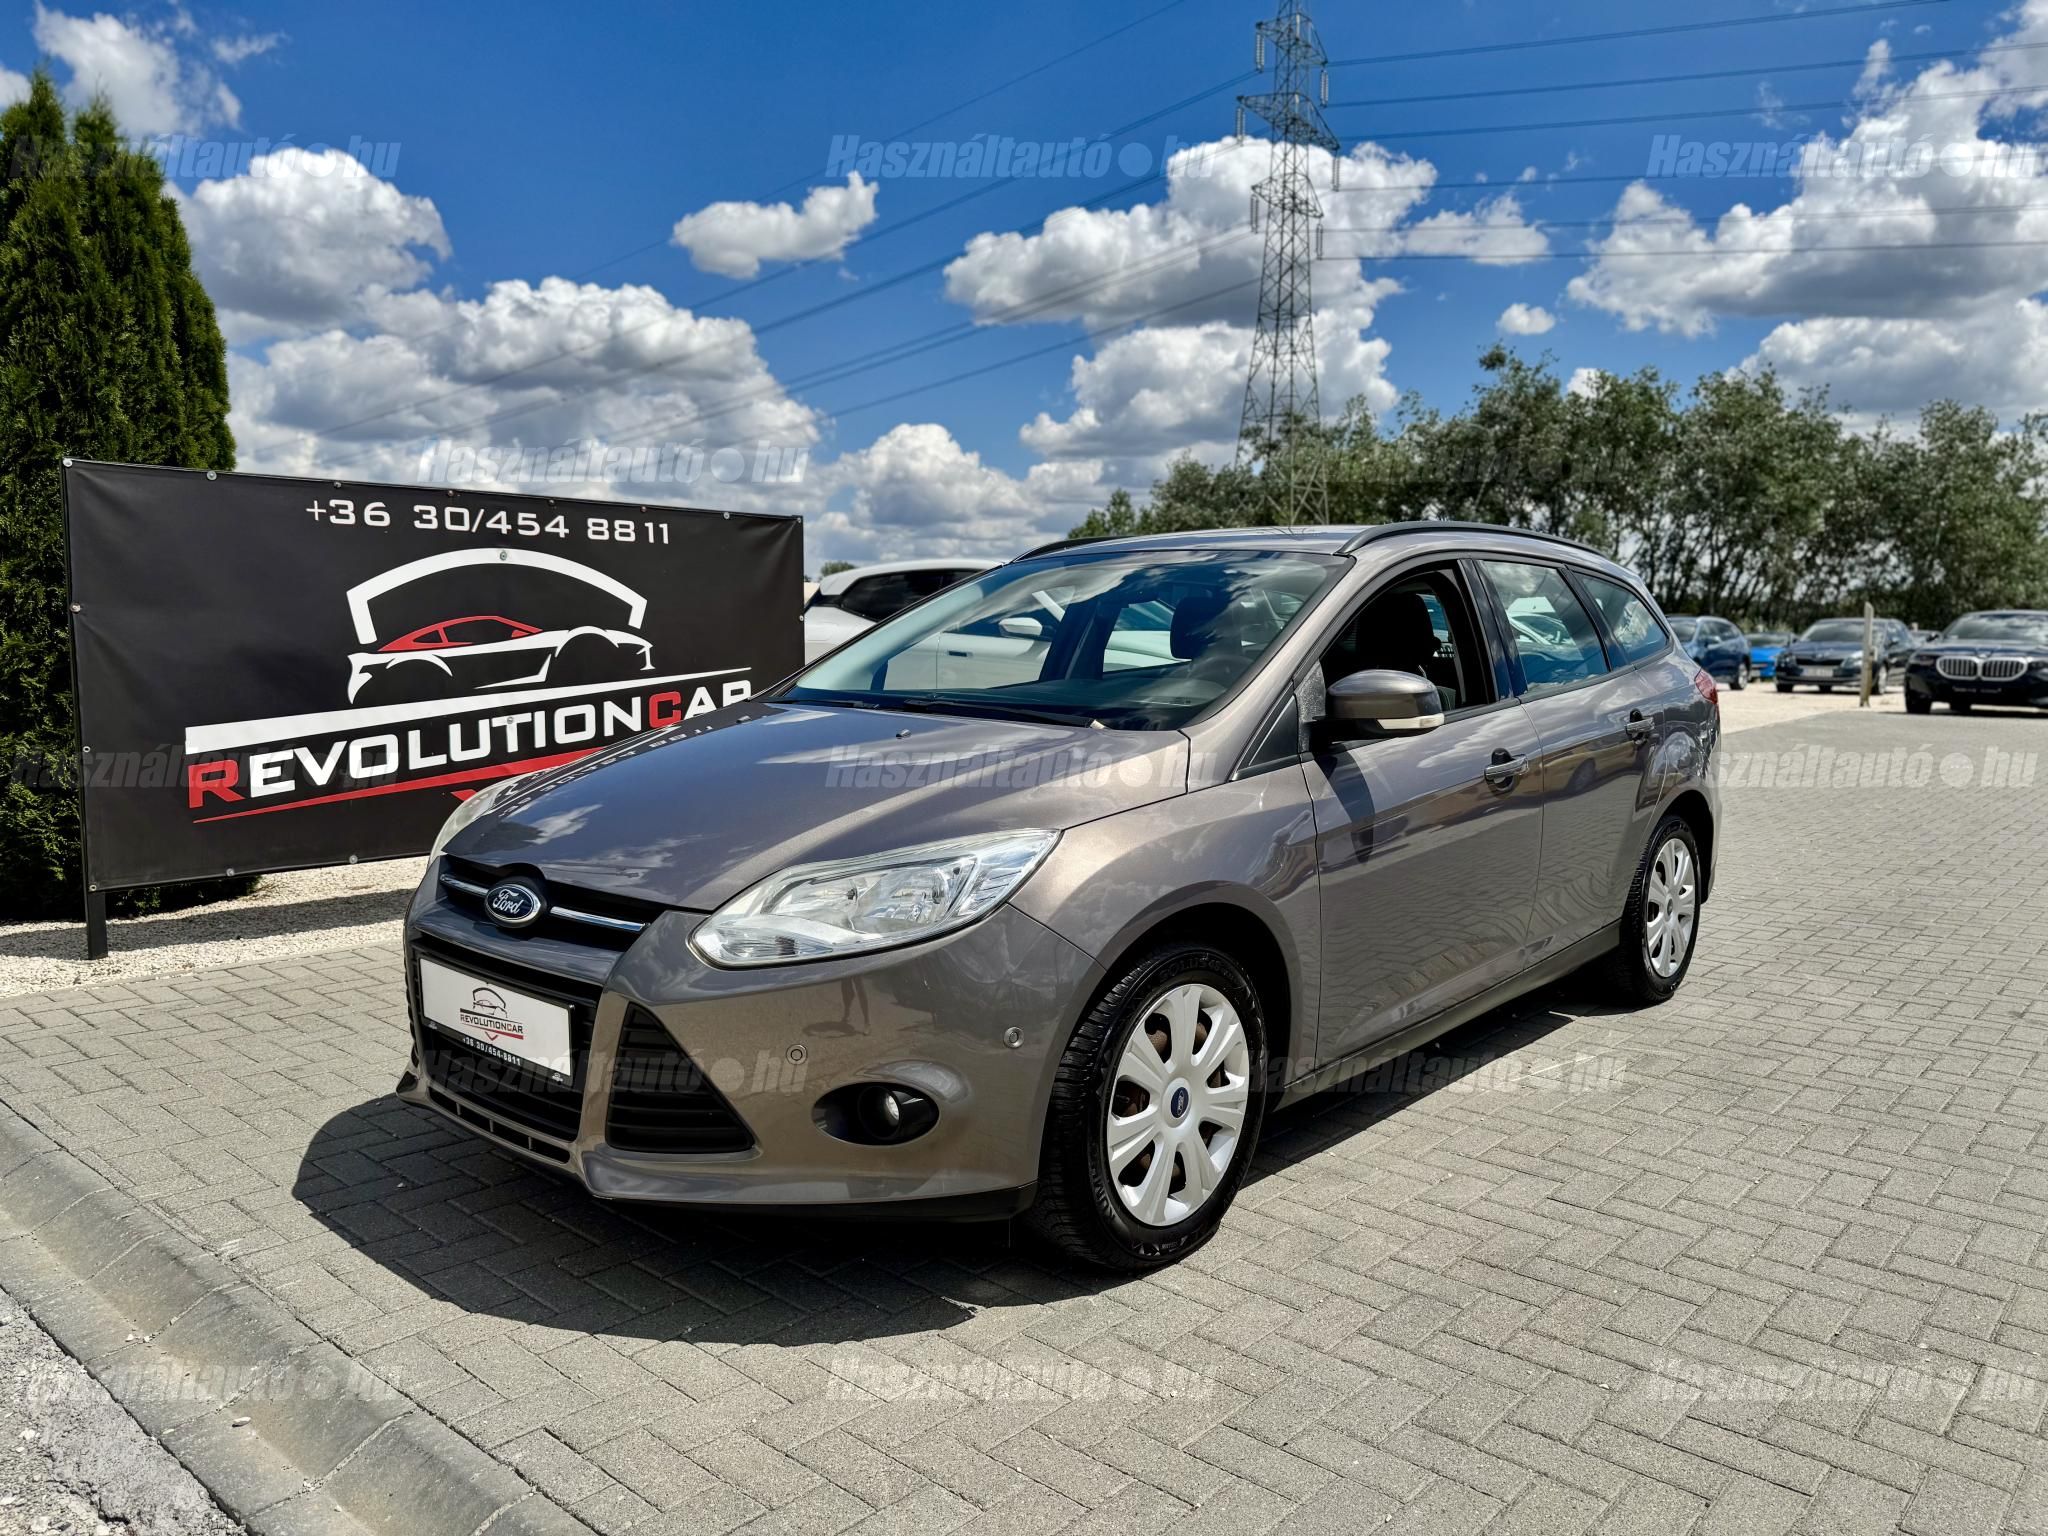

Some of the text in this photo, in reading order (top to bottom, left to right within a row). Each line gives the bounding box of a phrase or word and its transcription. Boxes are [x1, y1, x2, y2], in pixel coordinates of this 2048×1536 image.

[305, 498, 392, 528] +36
[413, 504, 570, 538] 30/454
[492, 888, 525, 914] Ford
[460, 1014, 523, 1034] REVOLUTIONCAR
